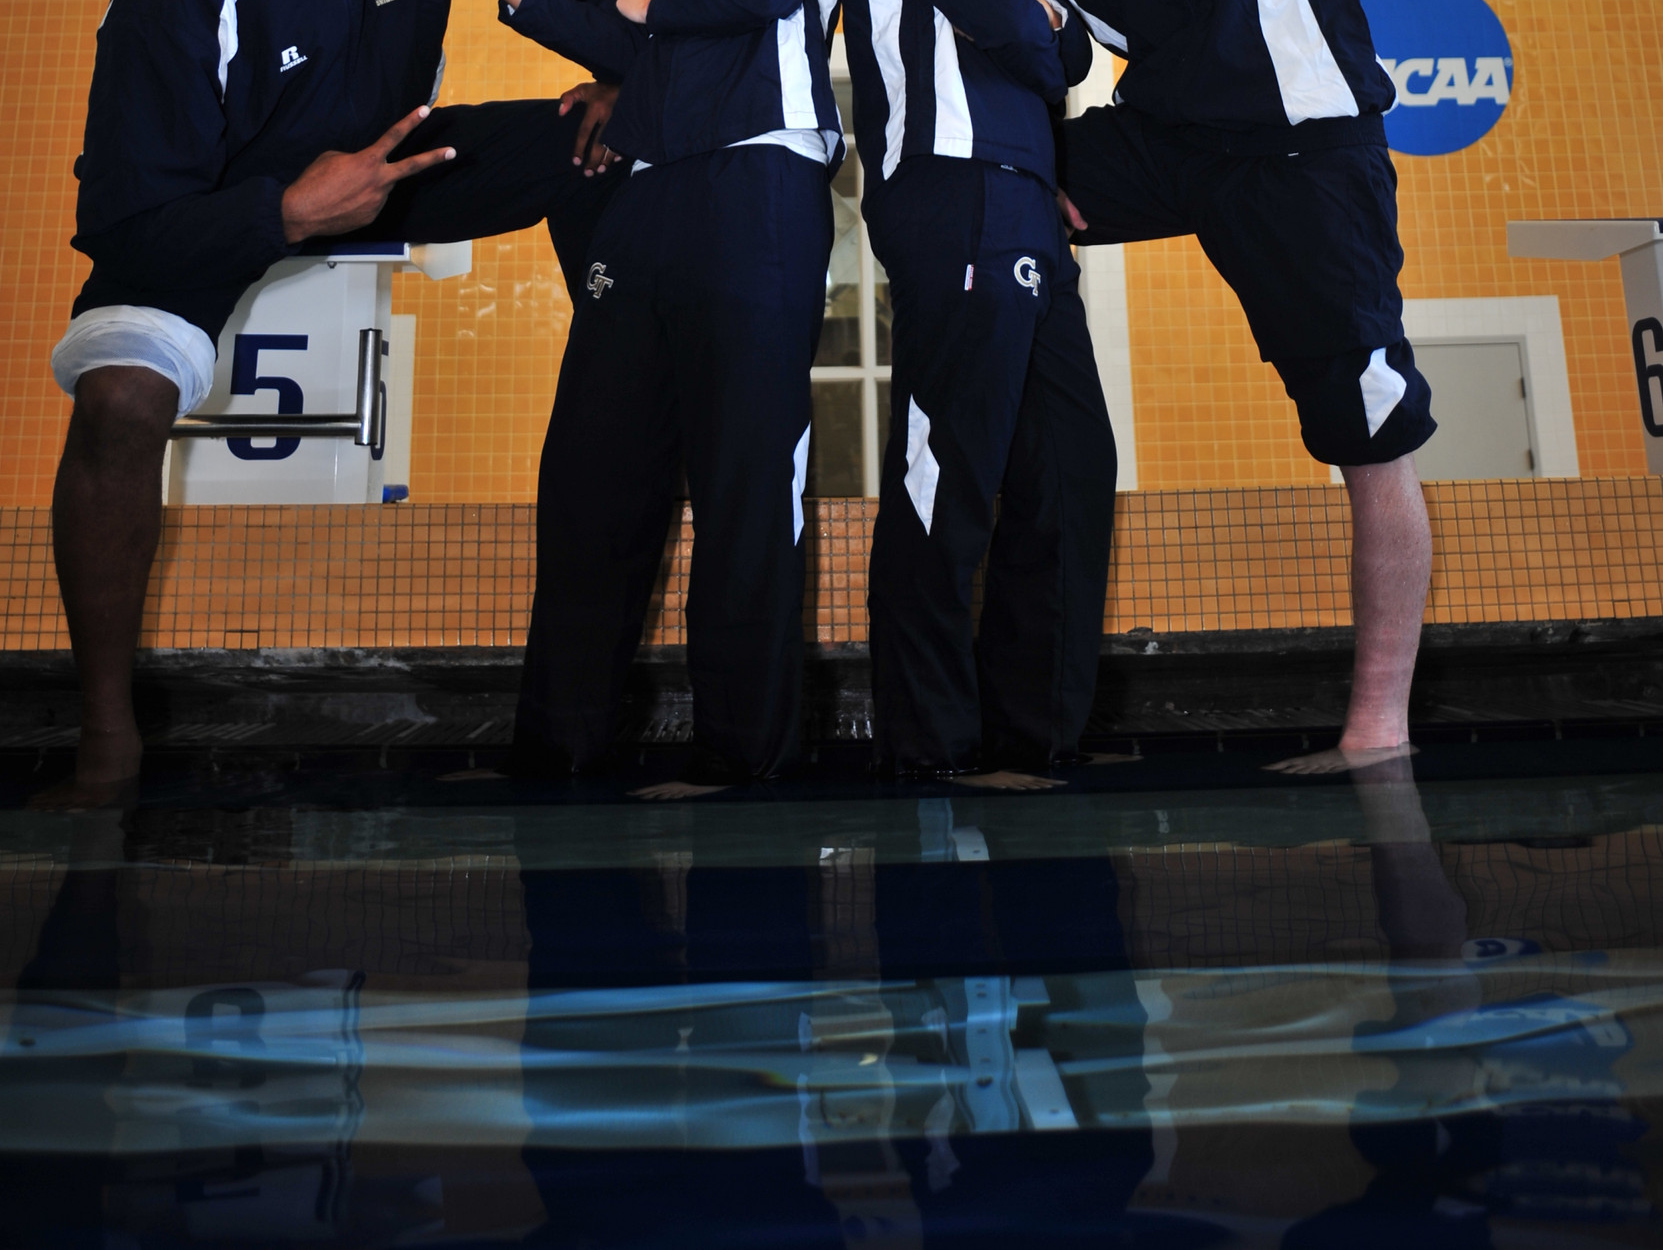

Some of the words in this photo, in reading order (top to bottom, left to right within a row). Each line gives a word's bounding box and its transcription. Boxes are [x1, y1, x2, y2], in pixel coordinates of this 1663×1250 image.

[280, 55, 308, 73] RUSSELL
[586, 261, 614, 299] GT
[1013, 256, 1041, 297] GT
[226, 333, 309, 461] 5
[1632, 316, 1663, 438] 6
